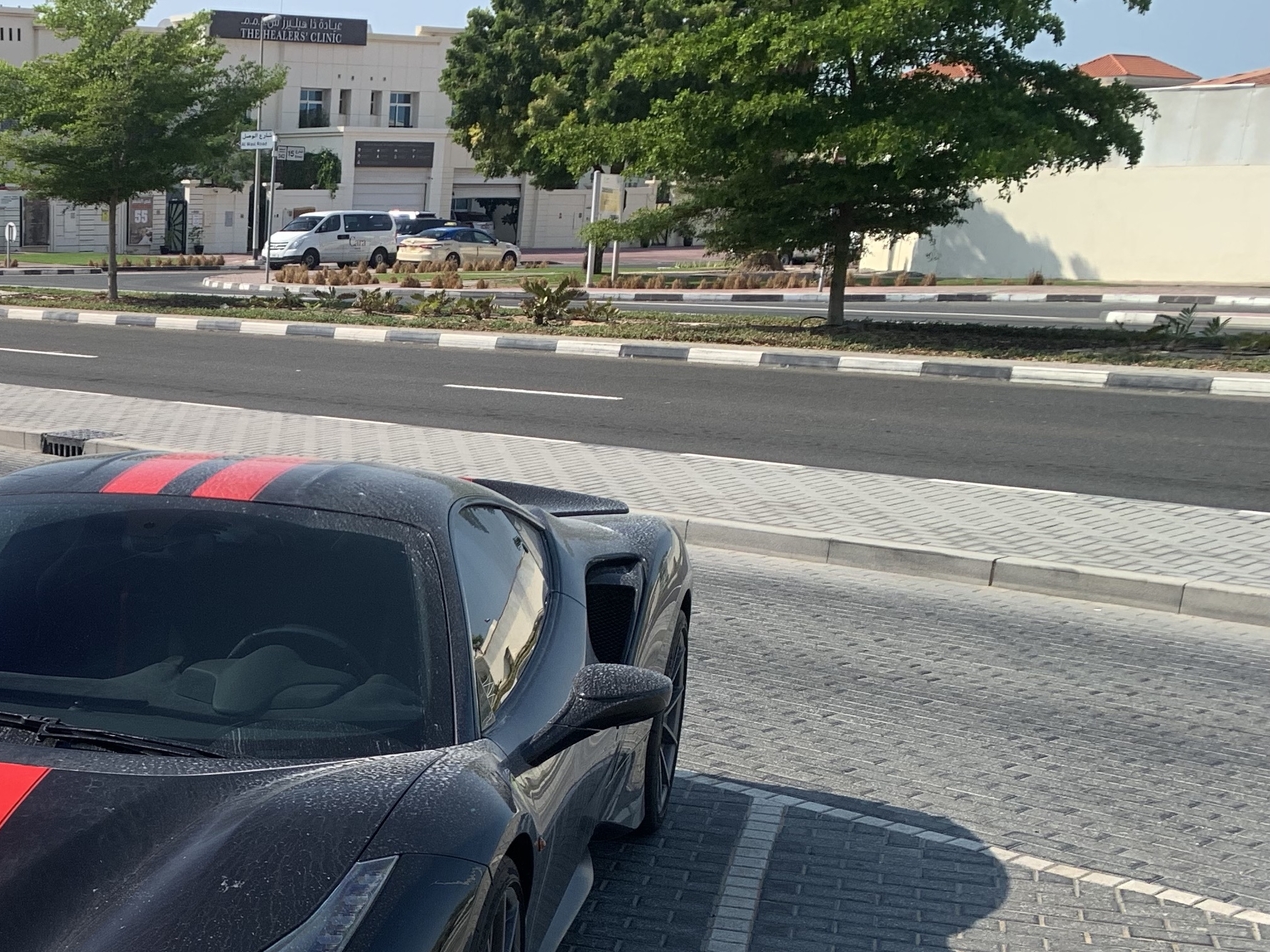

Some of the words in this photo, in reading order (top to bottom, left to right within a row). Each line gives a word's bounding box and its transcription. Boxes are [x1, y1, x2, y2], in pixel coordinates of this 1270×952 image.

[240, 28, 260, 39] THE
[310, 32, 342, 43] CLINIC
[134, 209, 149, 224] 55
